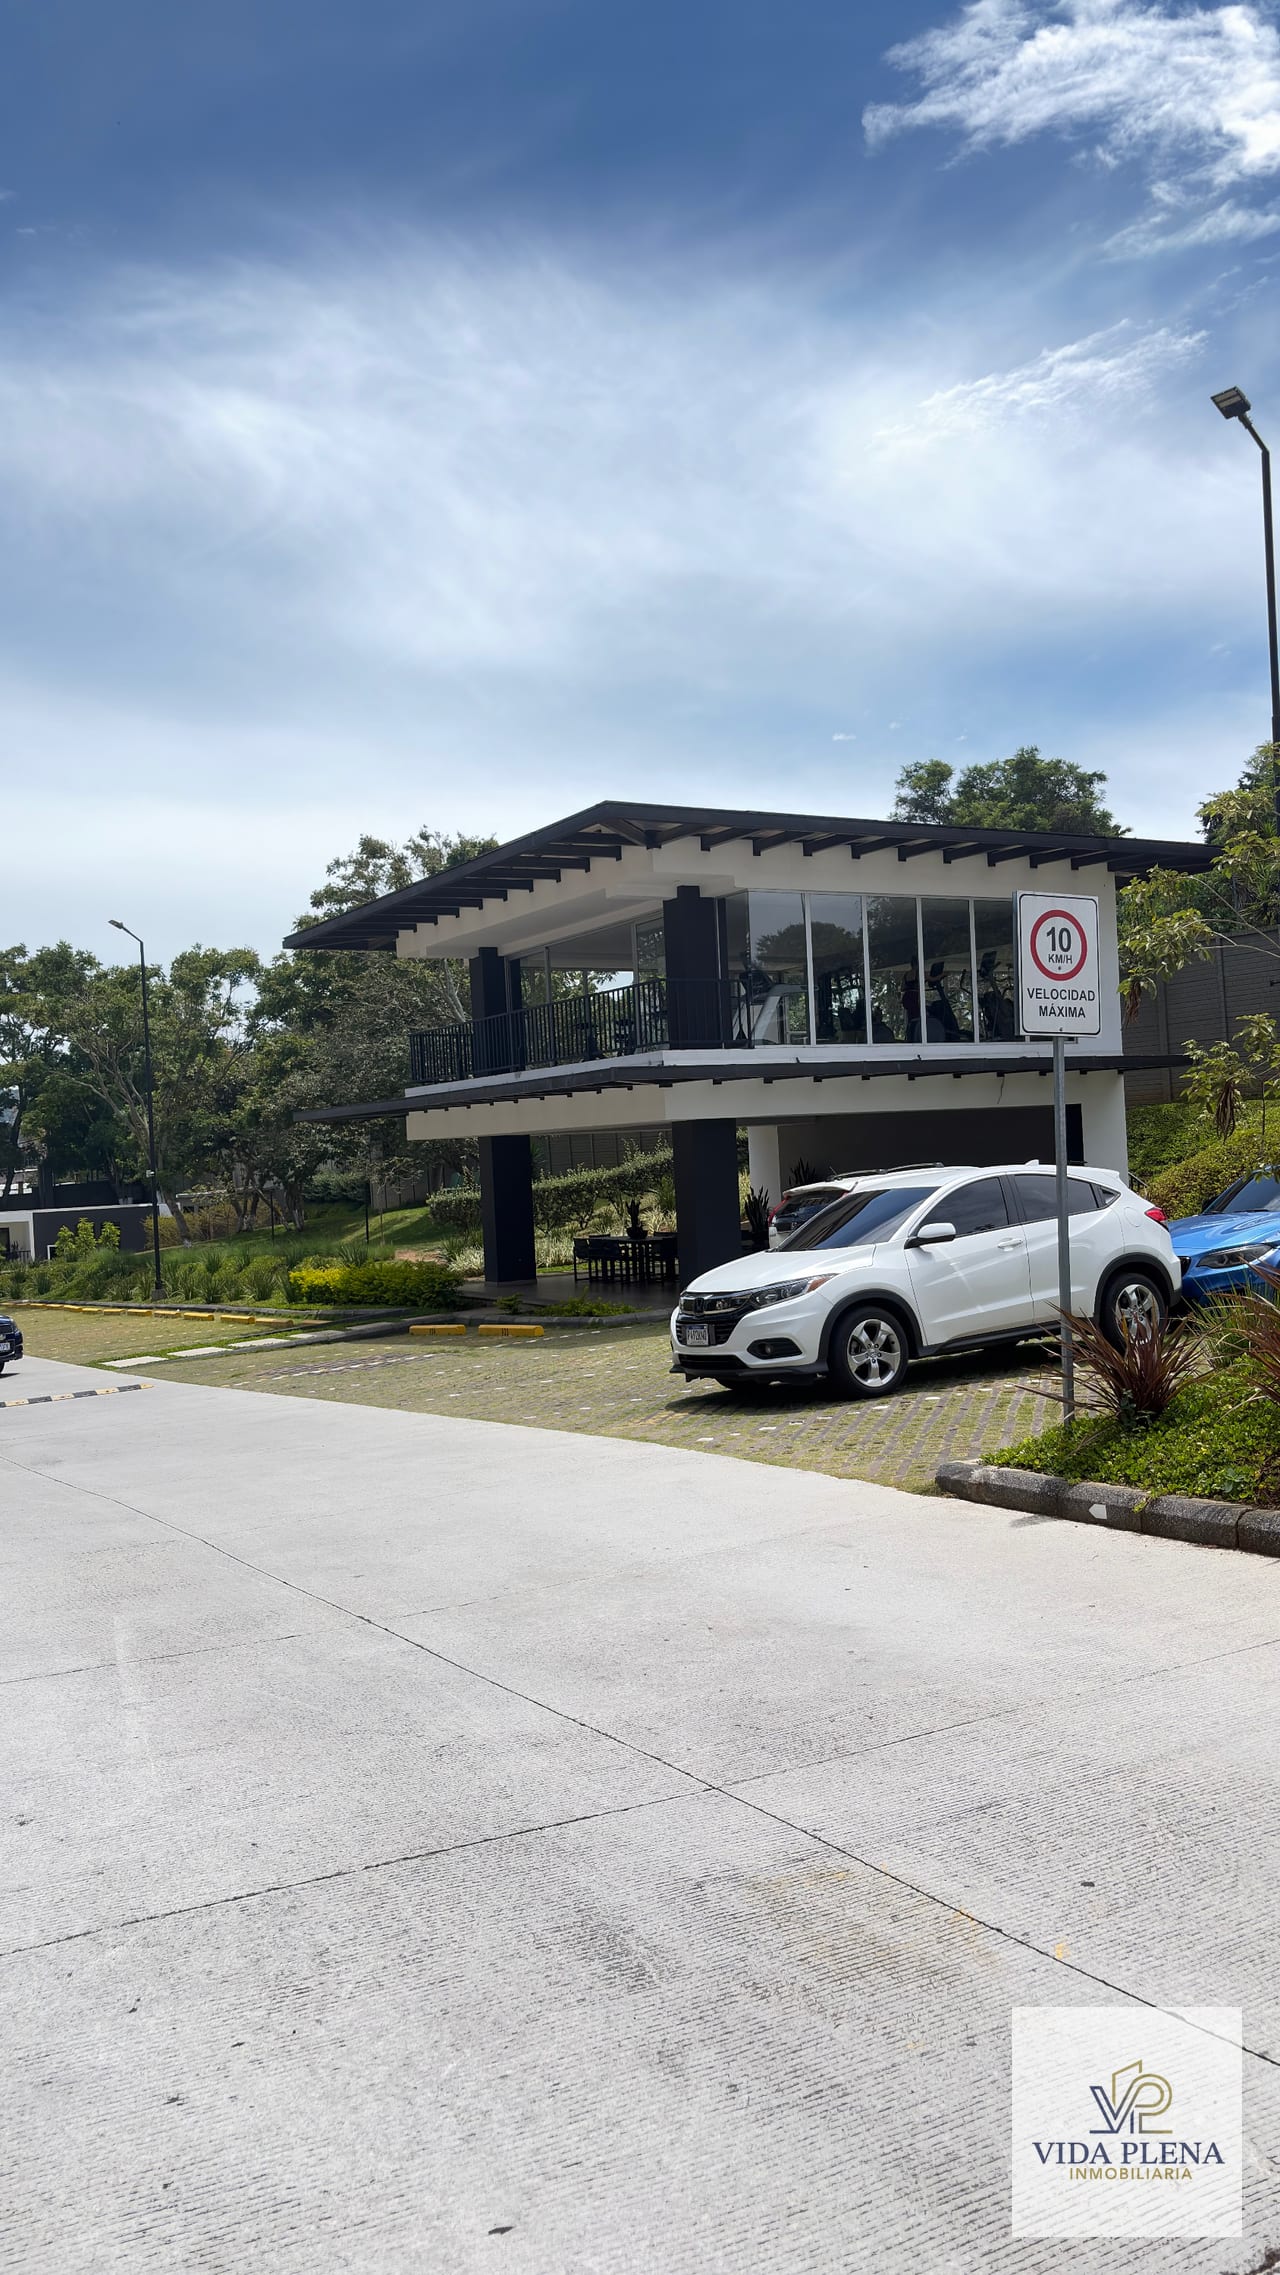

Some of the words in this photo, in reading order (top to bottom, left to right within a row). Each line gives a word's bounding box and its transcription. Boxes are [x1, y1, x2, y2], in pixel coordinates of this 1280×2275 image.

[1046, 926, 1072, 953] 10
[1048, 953, 1073, 964] KM/H
[1027, 988, 1096, 1001] VELOCIDAD
[1039, 1003, 1086, 1018] MÁXIMA
